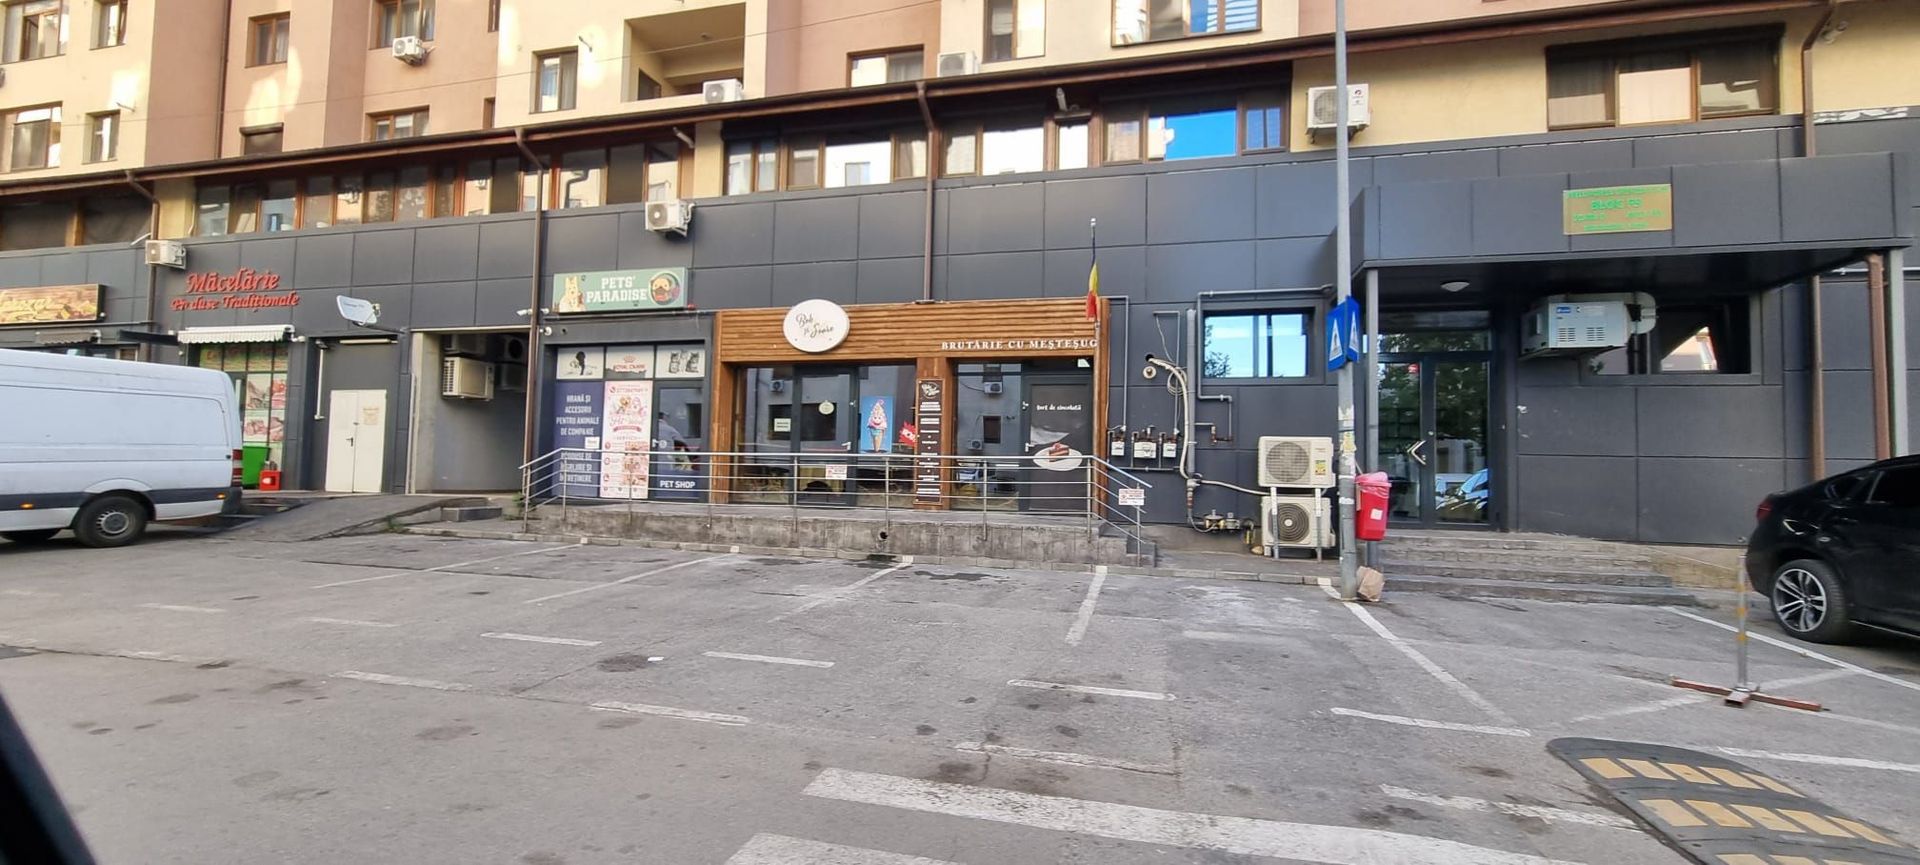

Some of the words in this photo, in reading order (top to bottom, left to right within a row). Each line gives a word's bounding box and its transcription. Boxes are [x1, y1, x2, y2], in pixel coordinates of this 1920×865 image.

[586, 288, 648, 303] PARADISE
[1008, 340, 1024, 349] CU
[659, 480, 674, 488] PET
[675, 480, 696, 489] SHOP
